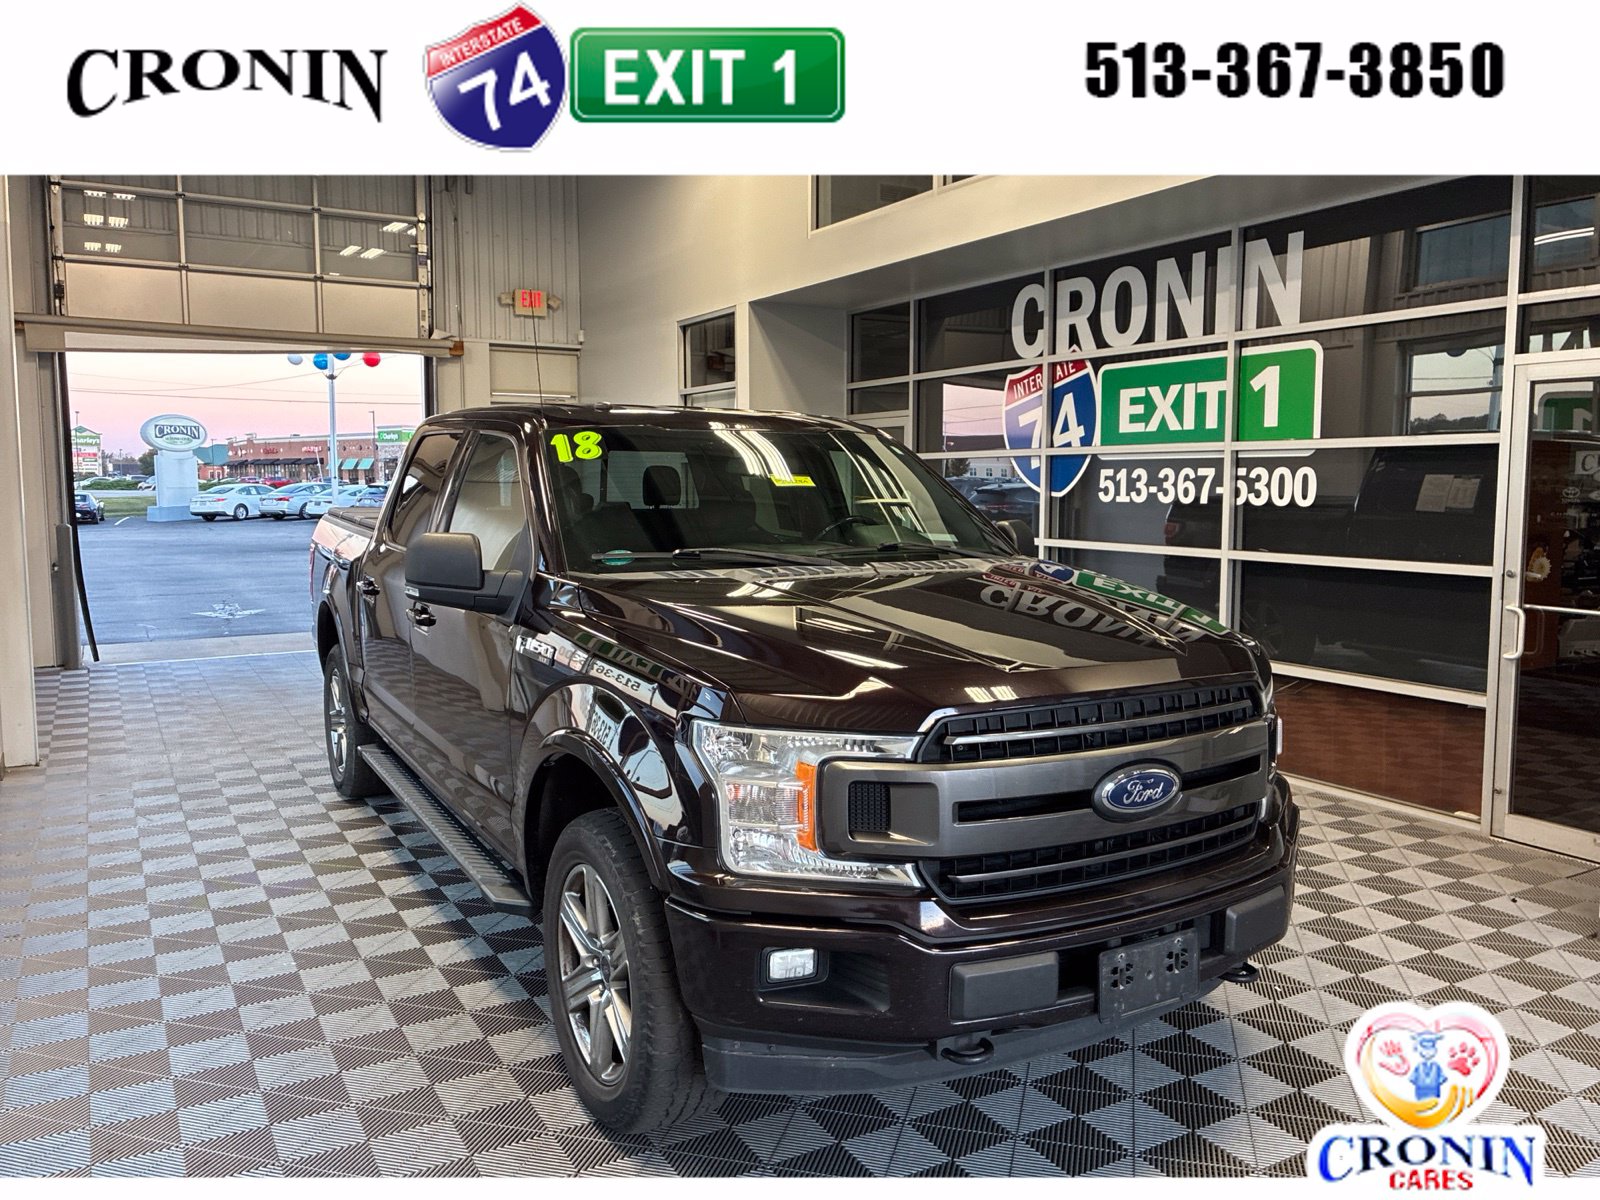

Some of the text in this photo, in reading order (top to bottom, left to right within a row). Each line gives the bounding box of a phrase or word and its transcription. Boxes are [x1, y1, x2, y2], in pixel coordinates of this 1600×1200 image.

[520, 289, 544, 308] EXIT
[1010, 230, 1305, 360] CRONIN
[1118, 364, 1281, 434] EXIT 1
[155, 424, 199, 440] CRONIN
[550, 430, 603, 463] 18
[1017, 391, 1086, 471] 74
[1097, 465, 1318, 508] 513-367-5300
[1122, 779, 1165, 805] Ford
